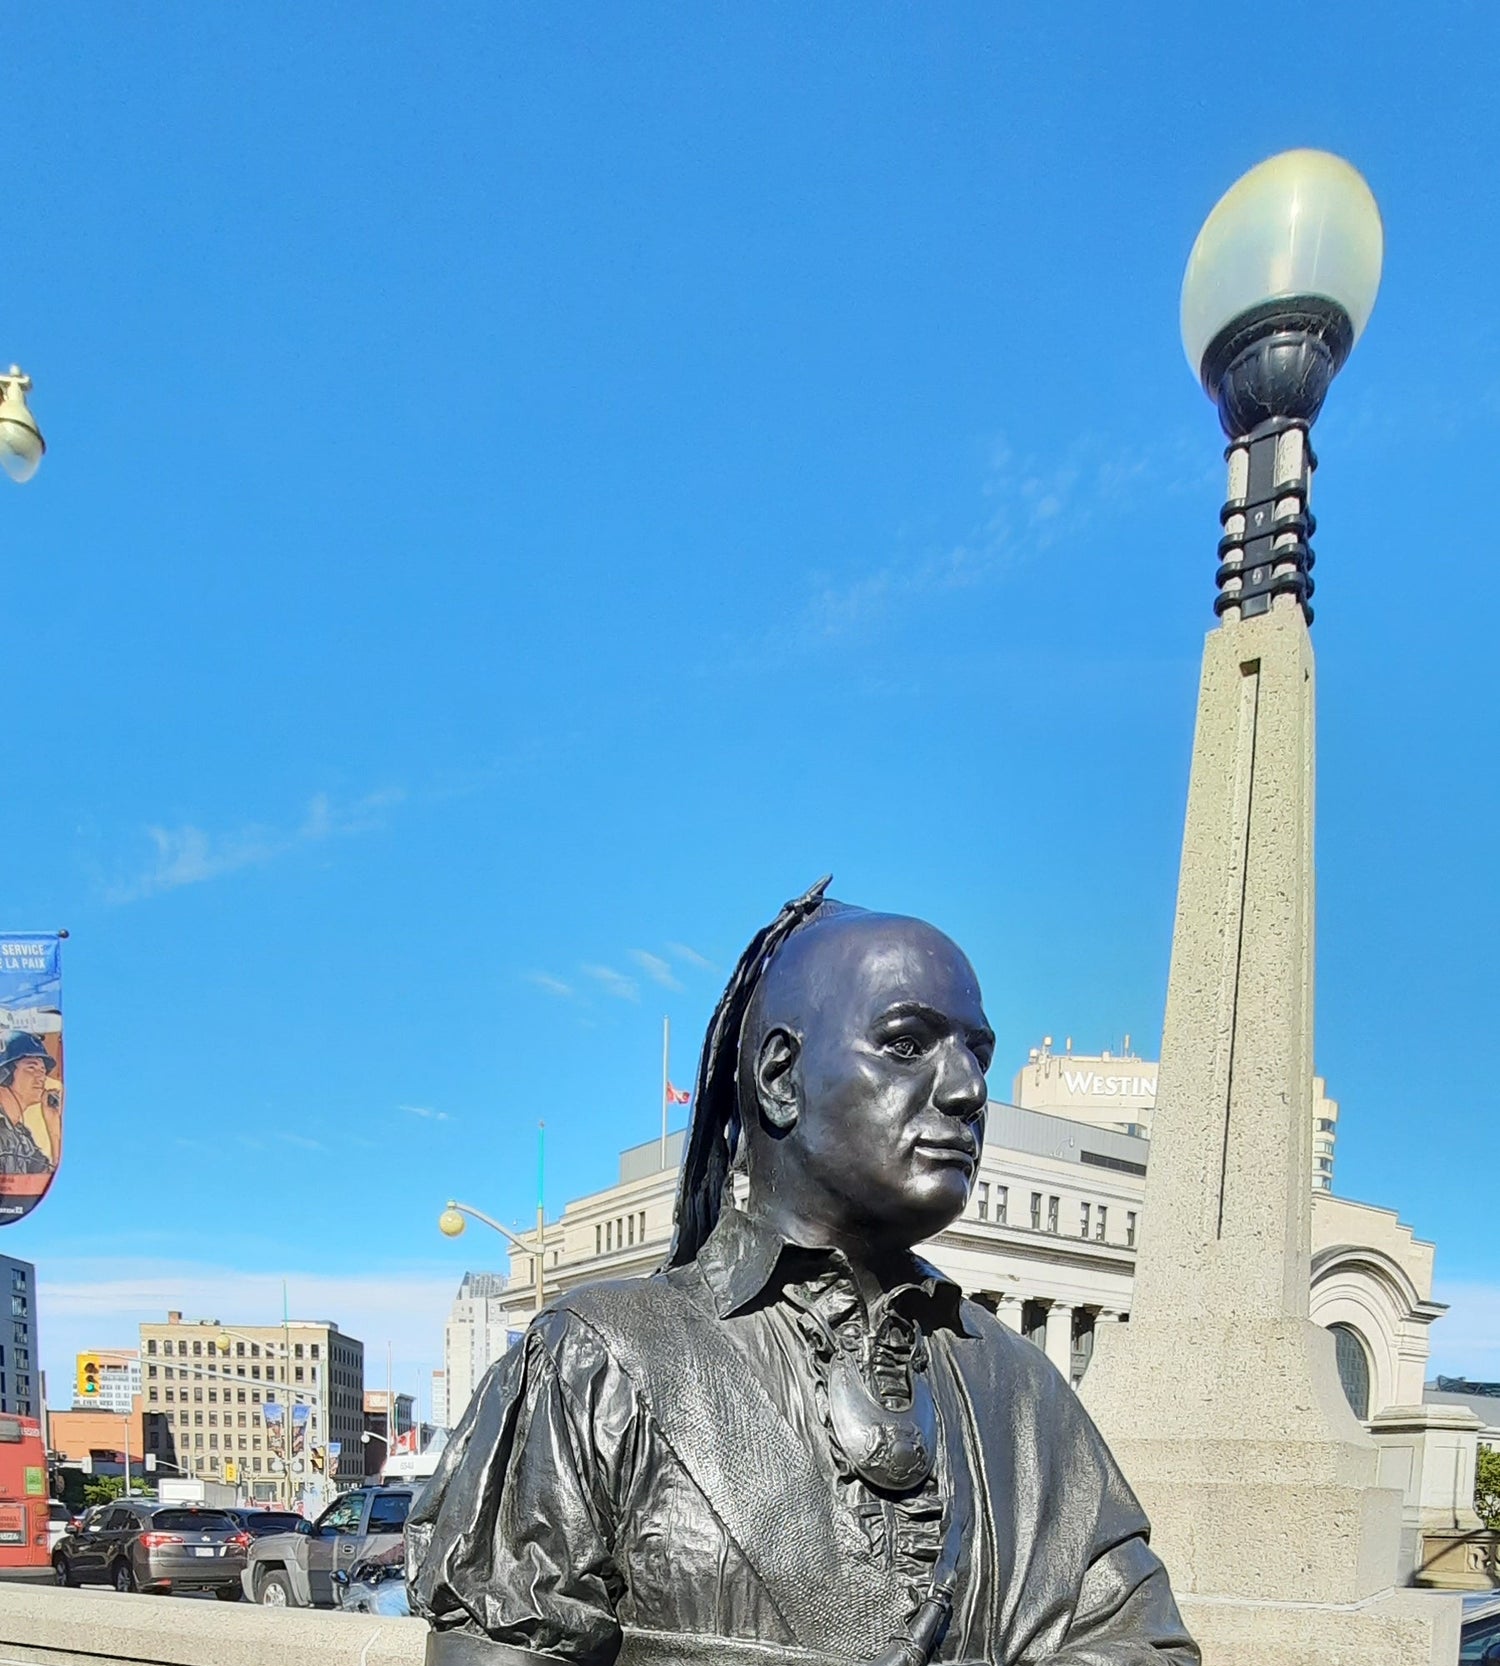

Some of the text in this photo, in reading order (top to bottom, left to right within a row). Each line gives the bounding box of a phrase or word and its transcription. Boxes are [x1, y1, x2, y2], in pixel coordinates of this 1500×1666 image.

[2, 943, 45, 956] SERVICE
[5, 957, 19, 969] LA
[21, 957, 46, 969] PAIX
[1063, 1071, 1158, 1096] WESTIN
